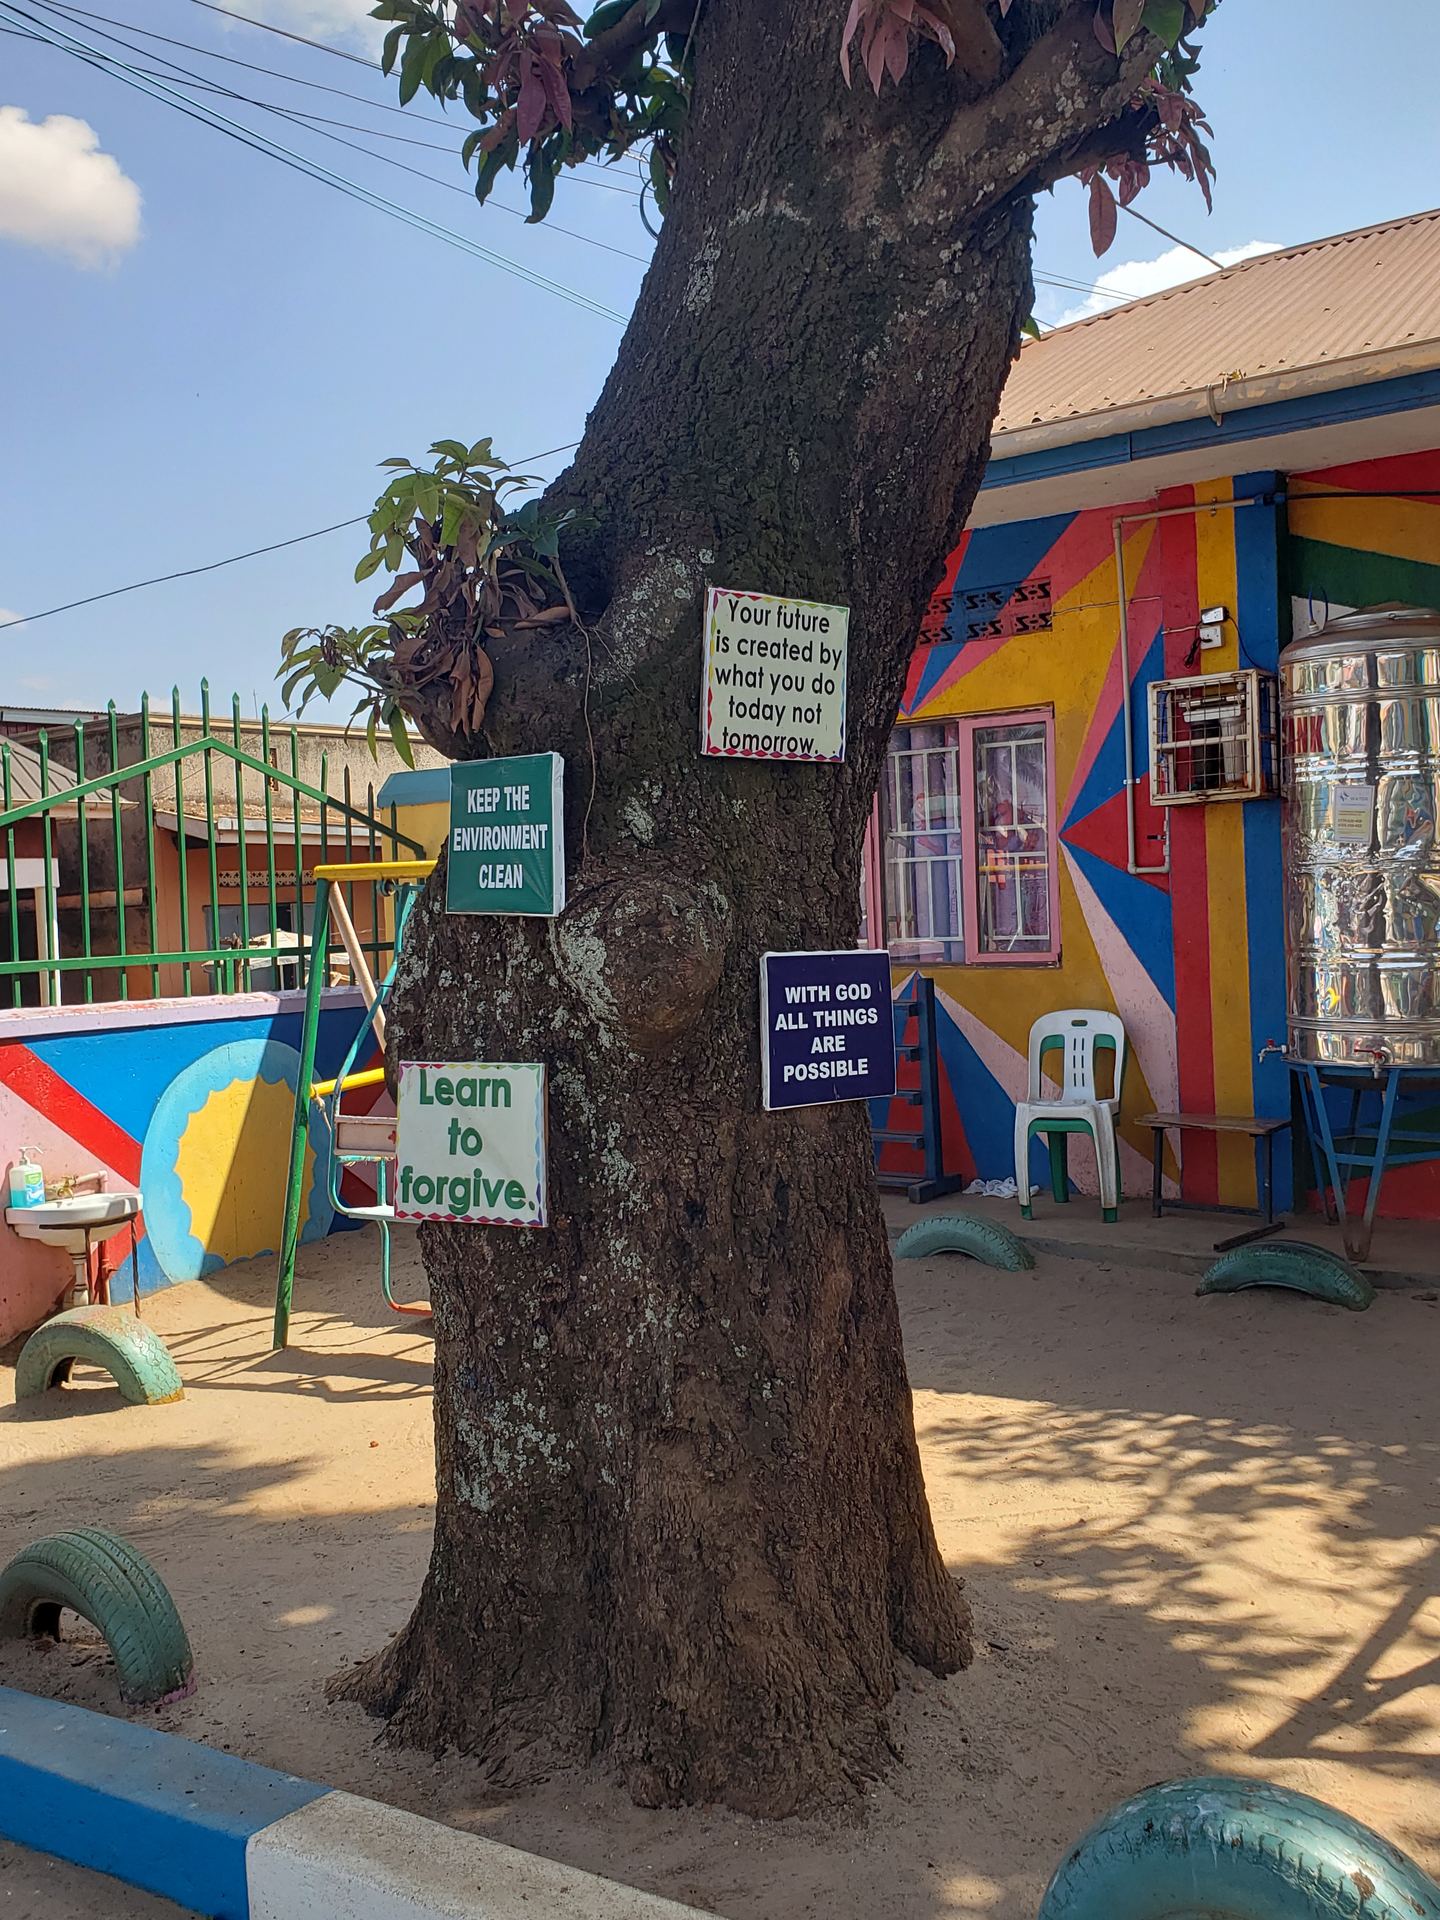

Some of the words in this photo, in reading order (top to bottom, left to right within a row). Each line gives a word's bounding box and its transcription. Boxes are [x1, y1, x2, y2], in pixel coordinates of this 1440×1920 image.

[729, 599, 771, 626] Your
[777, 606, 829, 633] future
[716, 630, 729, 653] is
[737, 638, 812, 662] created
[820, 642, 842, 670] by
[715, 664, 764, 688] what
[770, 673, 804, 695] you
[812, 673, 835, 695] do
[729, 696, 785, 726] today
[792, 703, 822, 724] not
[467, 788, 500, 813] KEEP
[504, 785, 530, 811] THE
[454, 824, 548, 851] ENVIRONMENT
[479, 864, 522, 888] CLEAN
[785, 986, 830, 1004] WITH
[836, 984, 871, 1001] GOD
[775, 1013, 808, 1031] ALL
[813, 1008, 878, 1028] THINGS
[811, 1035, 845, 1054] ARE
[784, 1059, 868, 1082] POSSIBLE
[420, 1069, 511, 1107] Learn
[448, 1118, 482, 1156] to
[401, 1165, 535, 1215] forgive.
